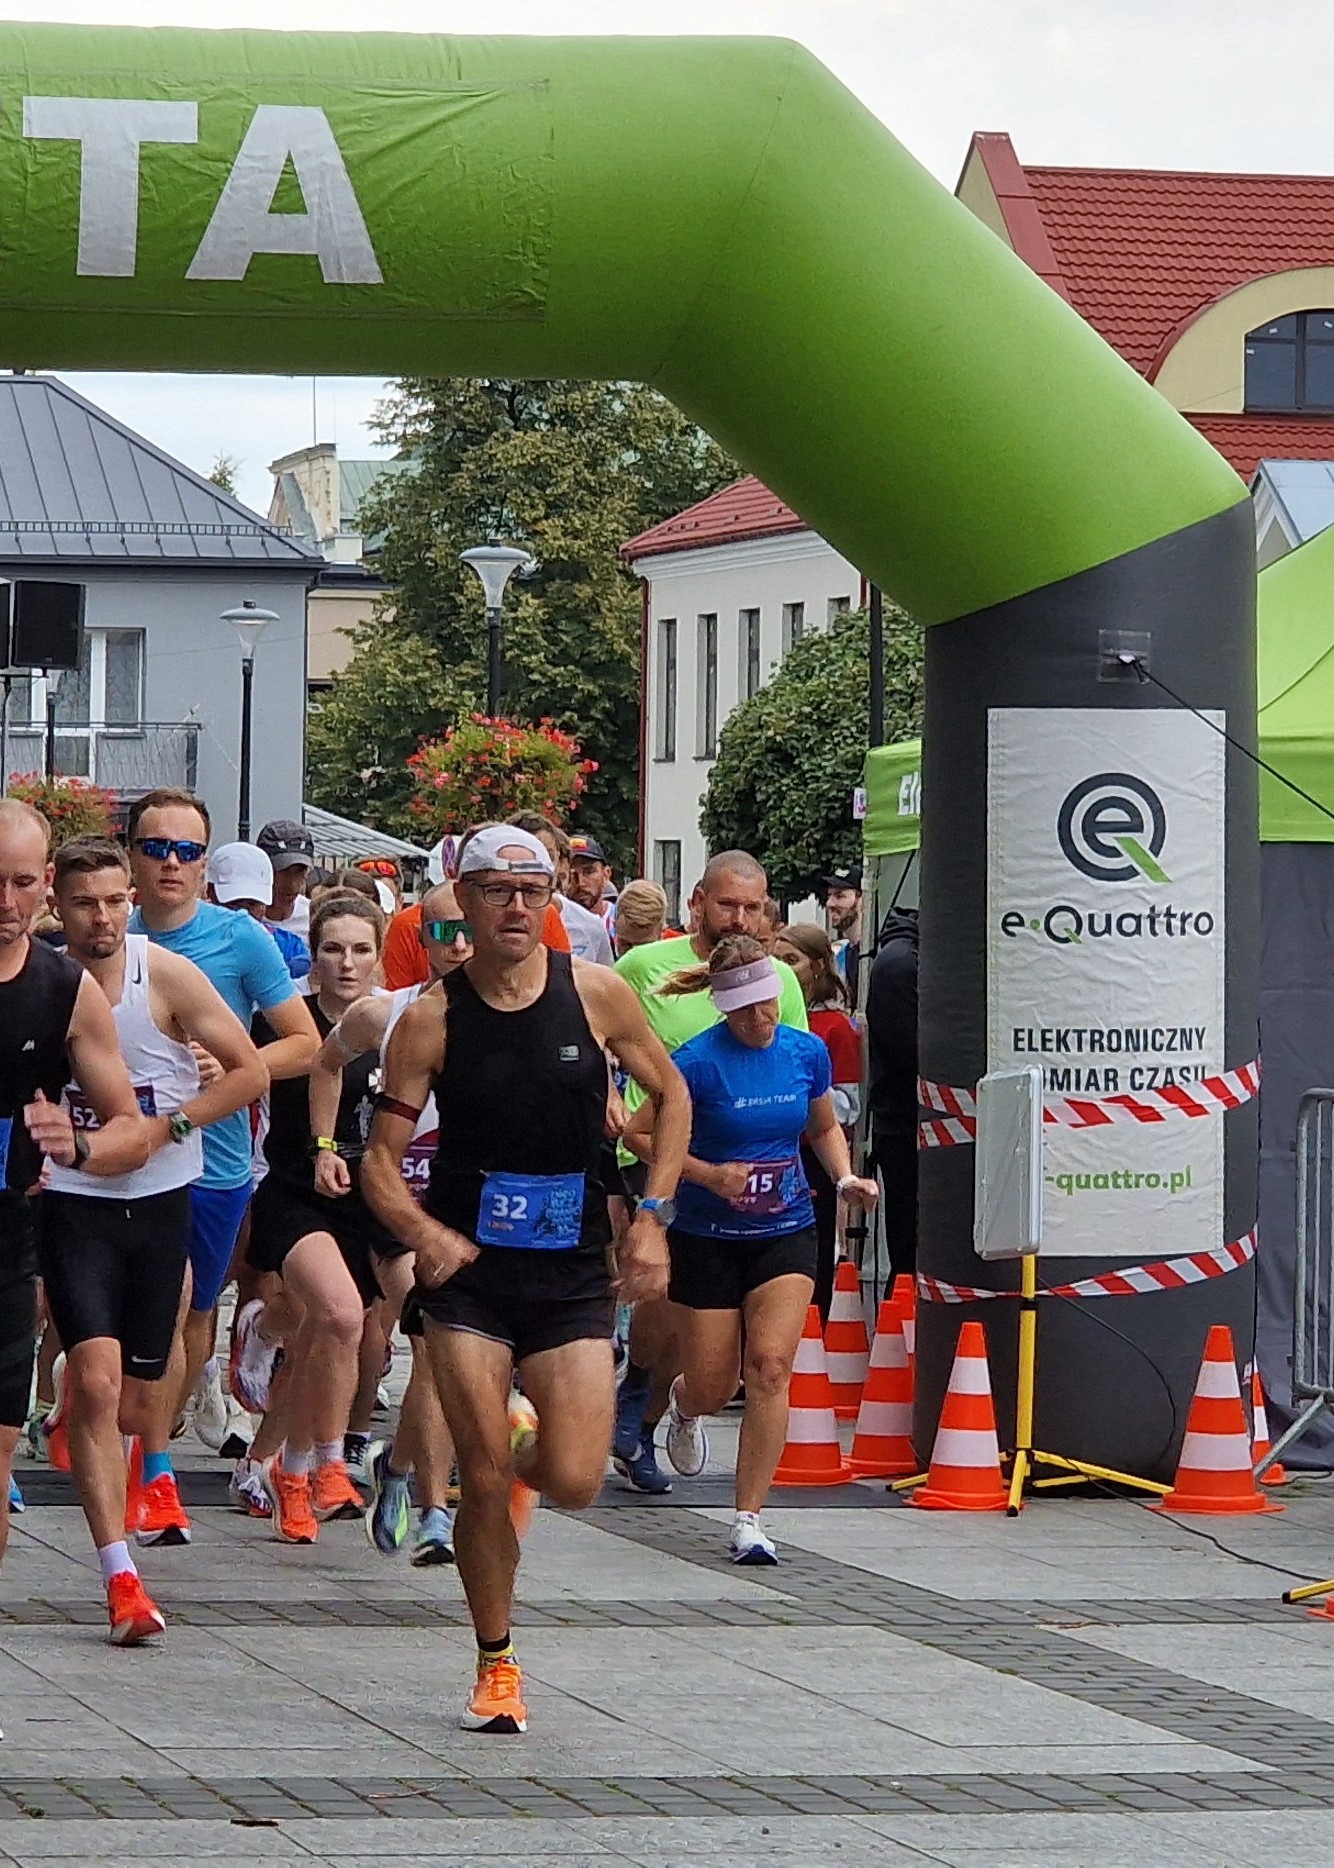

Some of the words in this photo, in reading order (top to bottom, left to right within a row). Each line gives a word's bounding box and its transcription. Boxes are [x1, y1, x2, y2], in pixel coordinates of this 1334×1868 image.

[1012, 1026, 1207, 1053] ELEKTRONICZNY
[748, 1172, 774, 1194] 15
[1044, 1164, 1192, 1197] -quattro.pl
[491, 1193, 529, 1221] 32
